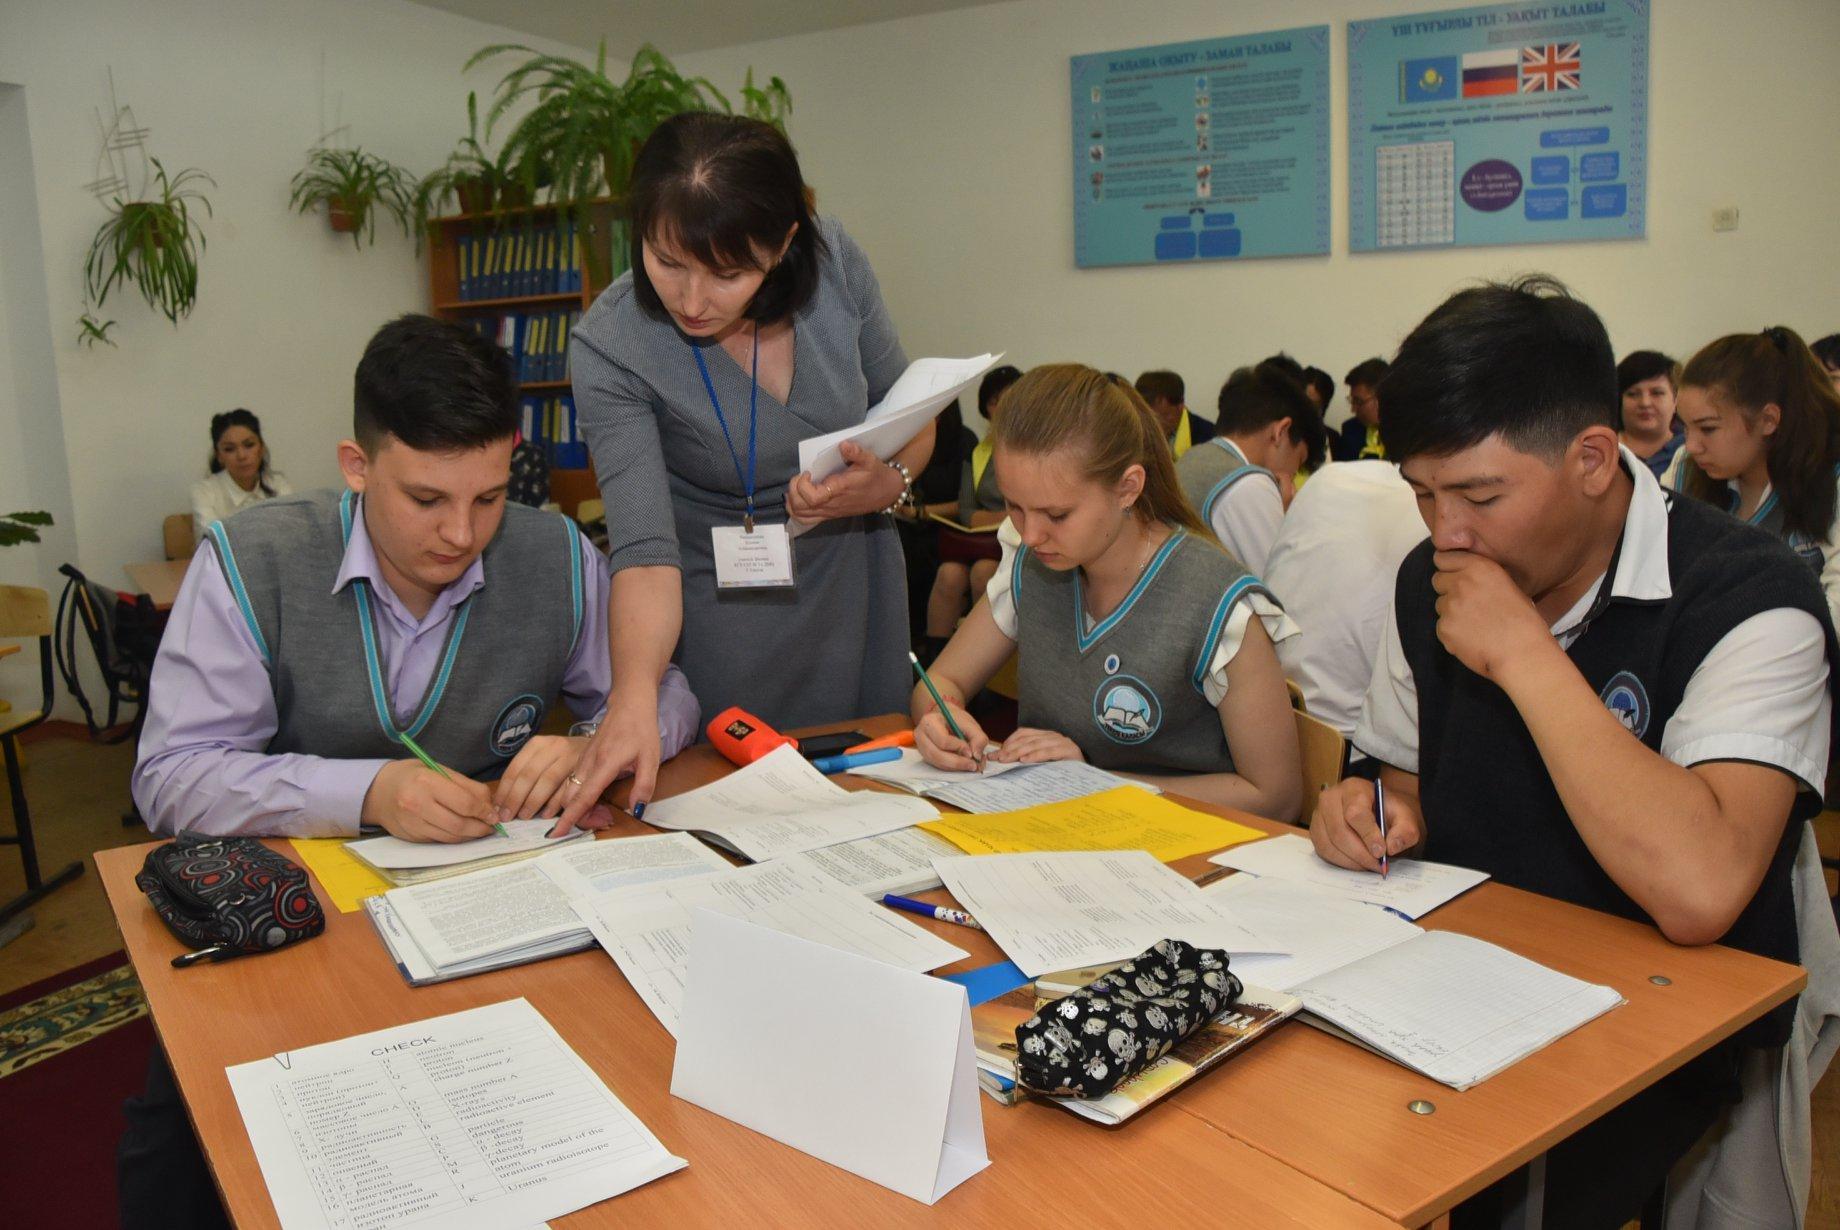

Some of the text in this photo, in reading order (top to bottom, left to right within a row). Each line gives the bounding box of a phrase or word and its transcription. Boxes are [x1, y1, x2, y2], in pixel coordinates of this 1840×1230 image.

[371, 1035, 437, 1057] CHECK
[456, 1096, 516, 1115] radioactivity
[460, 1091, 554, 1121] radioactive element
[467, 1119, 505, 1133] particle
[472, 1121, 524, 1138] dangerous
[490, 1147, 537, 1166] planetary
[541, 1136, 572, 1150] model
[495, 1161, 521, 1172] atom
[499, 1143, 609, 1179] uranium radioisotope
[508, 1177, 547, 1191] Uranus
